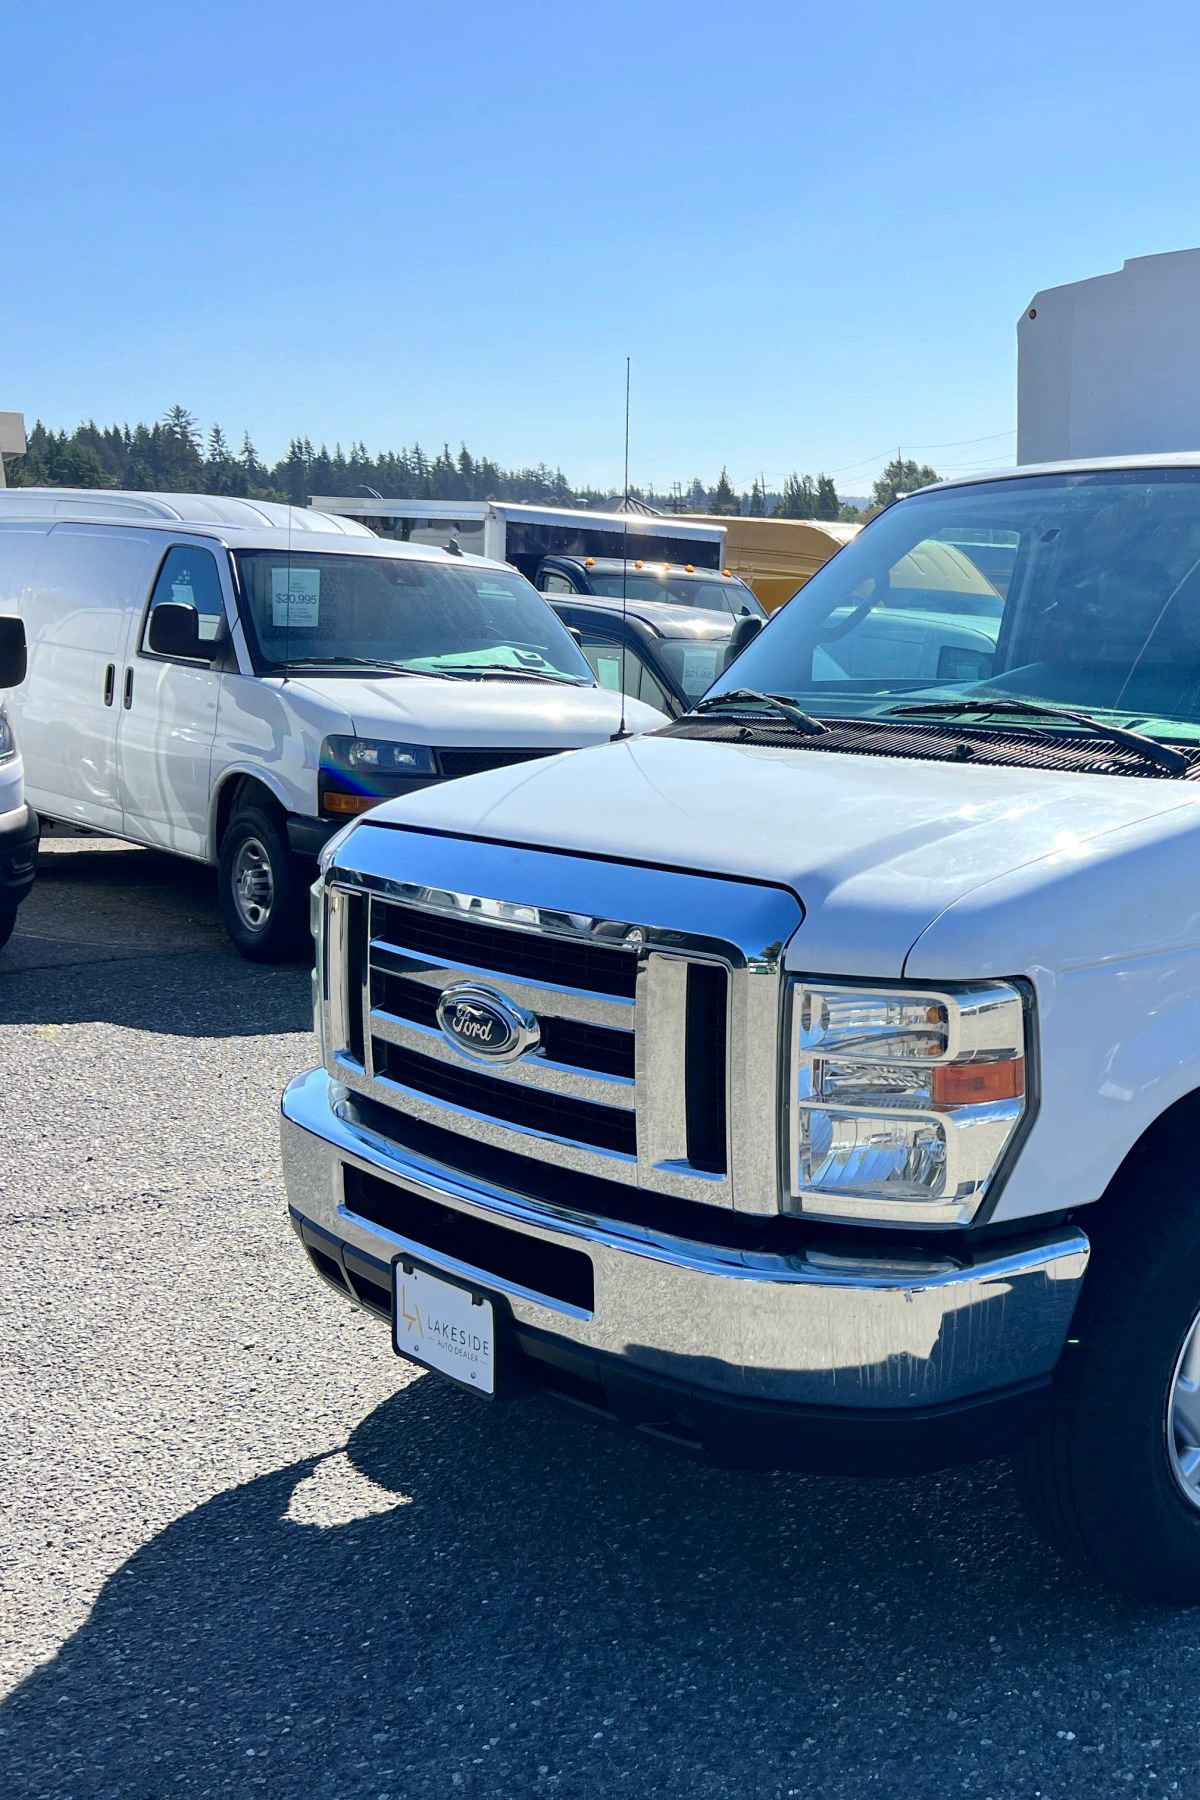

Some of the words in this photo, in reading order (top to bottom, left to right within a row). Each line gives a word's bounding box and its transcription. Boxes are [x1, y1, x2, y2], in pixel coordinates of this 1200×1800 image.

[275, 593, 317, 605] $20,995
[452, 1004, 493, 1041] Ford
[427, 1315, 490, 1356] LAKESIDE
[437, 1339, 454, 1353] AUTO
[455, 1348, 479, 1363] DEALER
